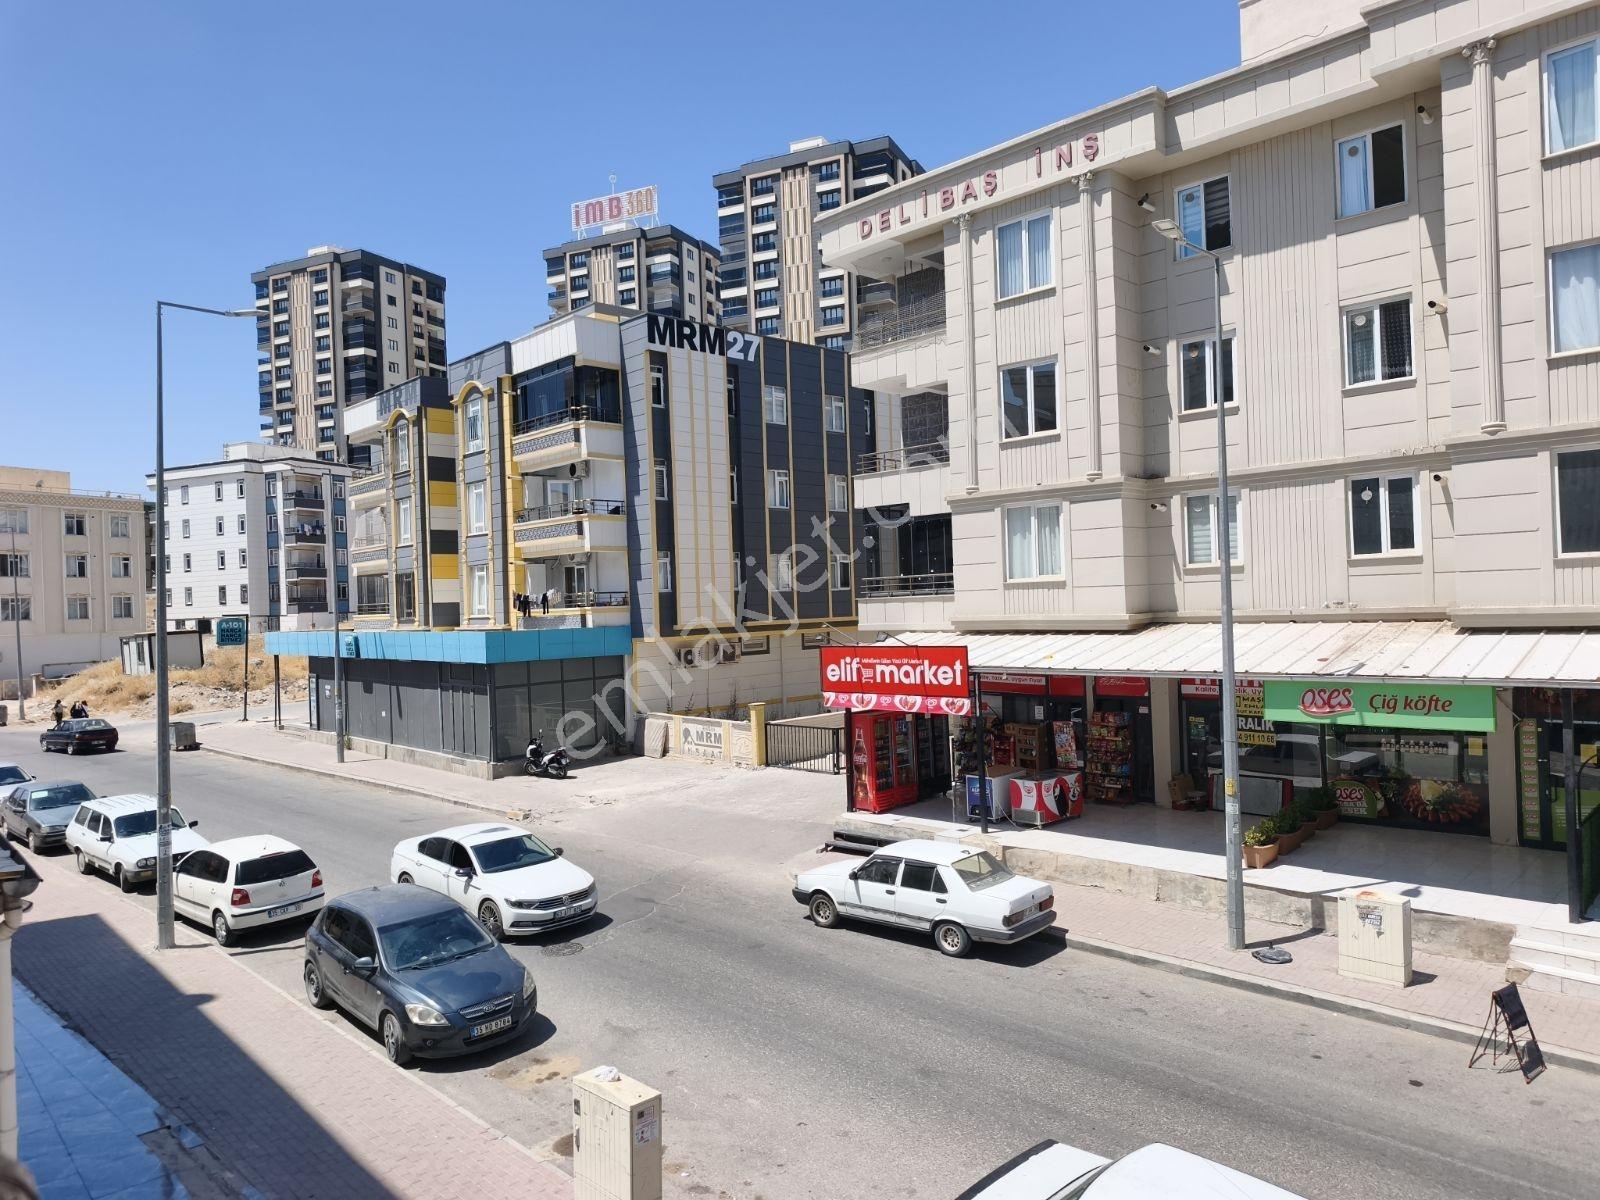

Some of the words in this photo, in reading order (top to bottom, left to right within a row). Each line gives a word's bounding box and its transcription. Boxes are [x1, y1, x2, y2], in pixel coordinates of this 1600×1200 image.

[858, 170, 997, 240] DELİBAŞ
[1035, 133, 1099, 177] İNŞ
[827, 656, 860, 682] elif
[876, 659, 963, 686] market
[1369, 694, 1398, 714] Çiğ
[1403, 695, 1453, 716] köfte
[1238, 717, 1275, 731] RALIK
